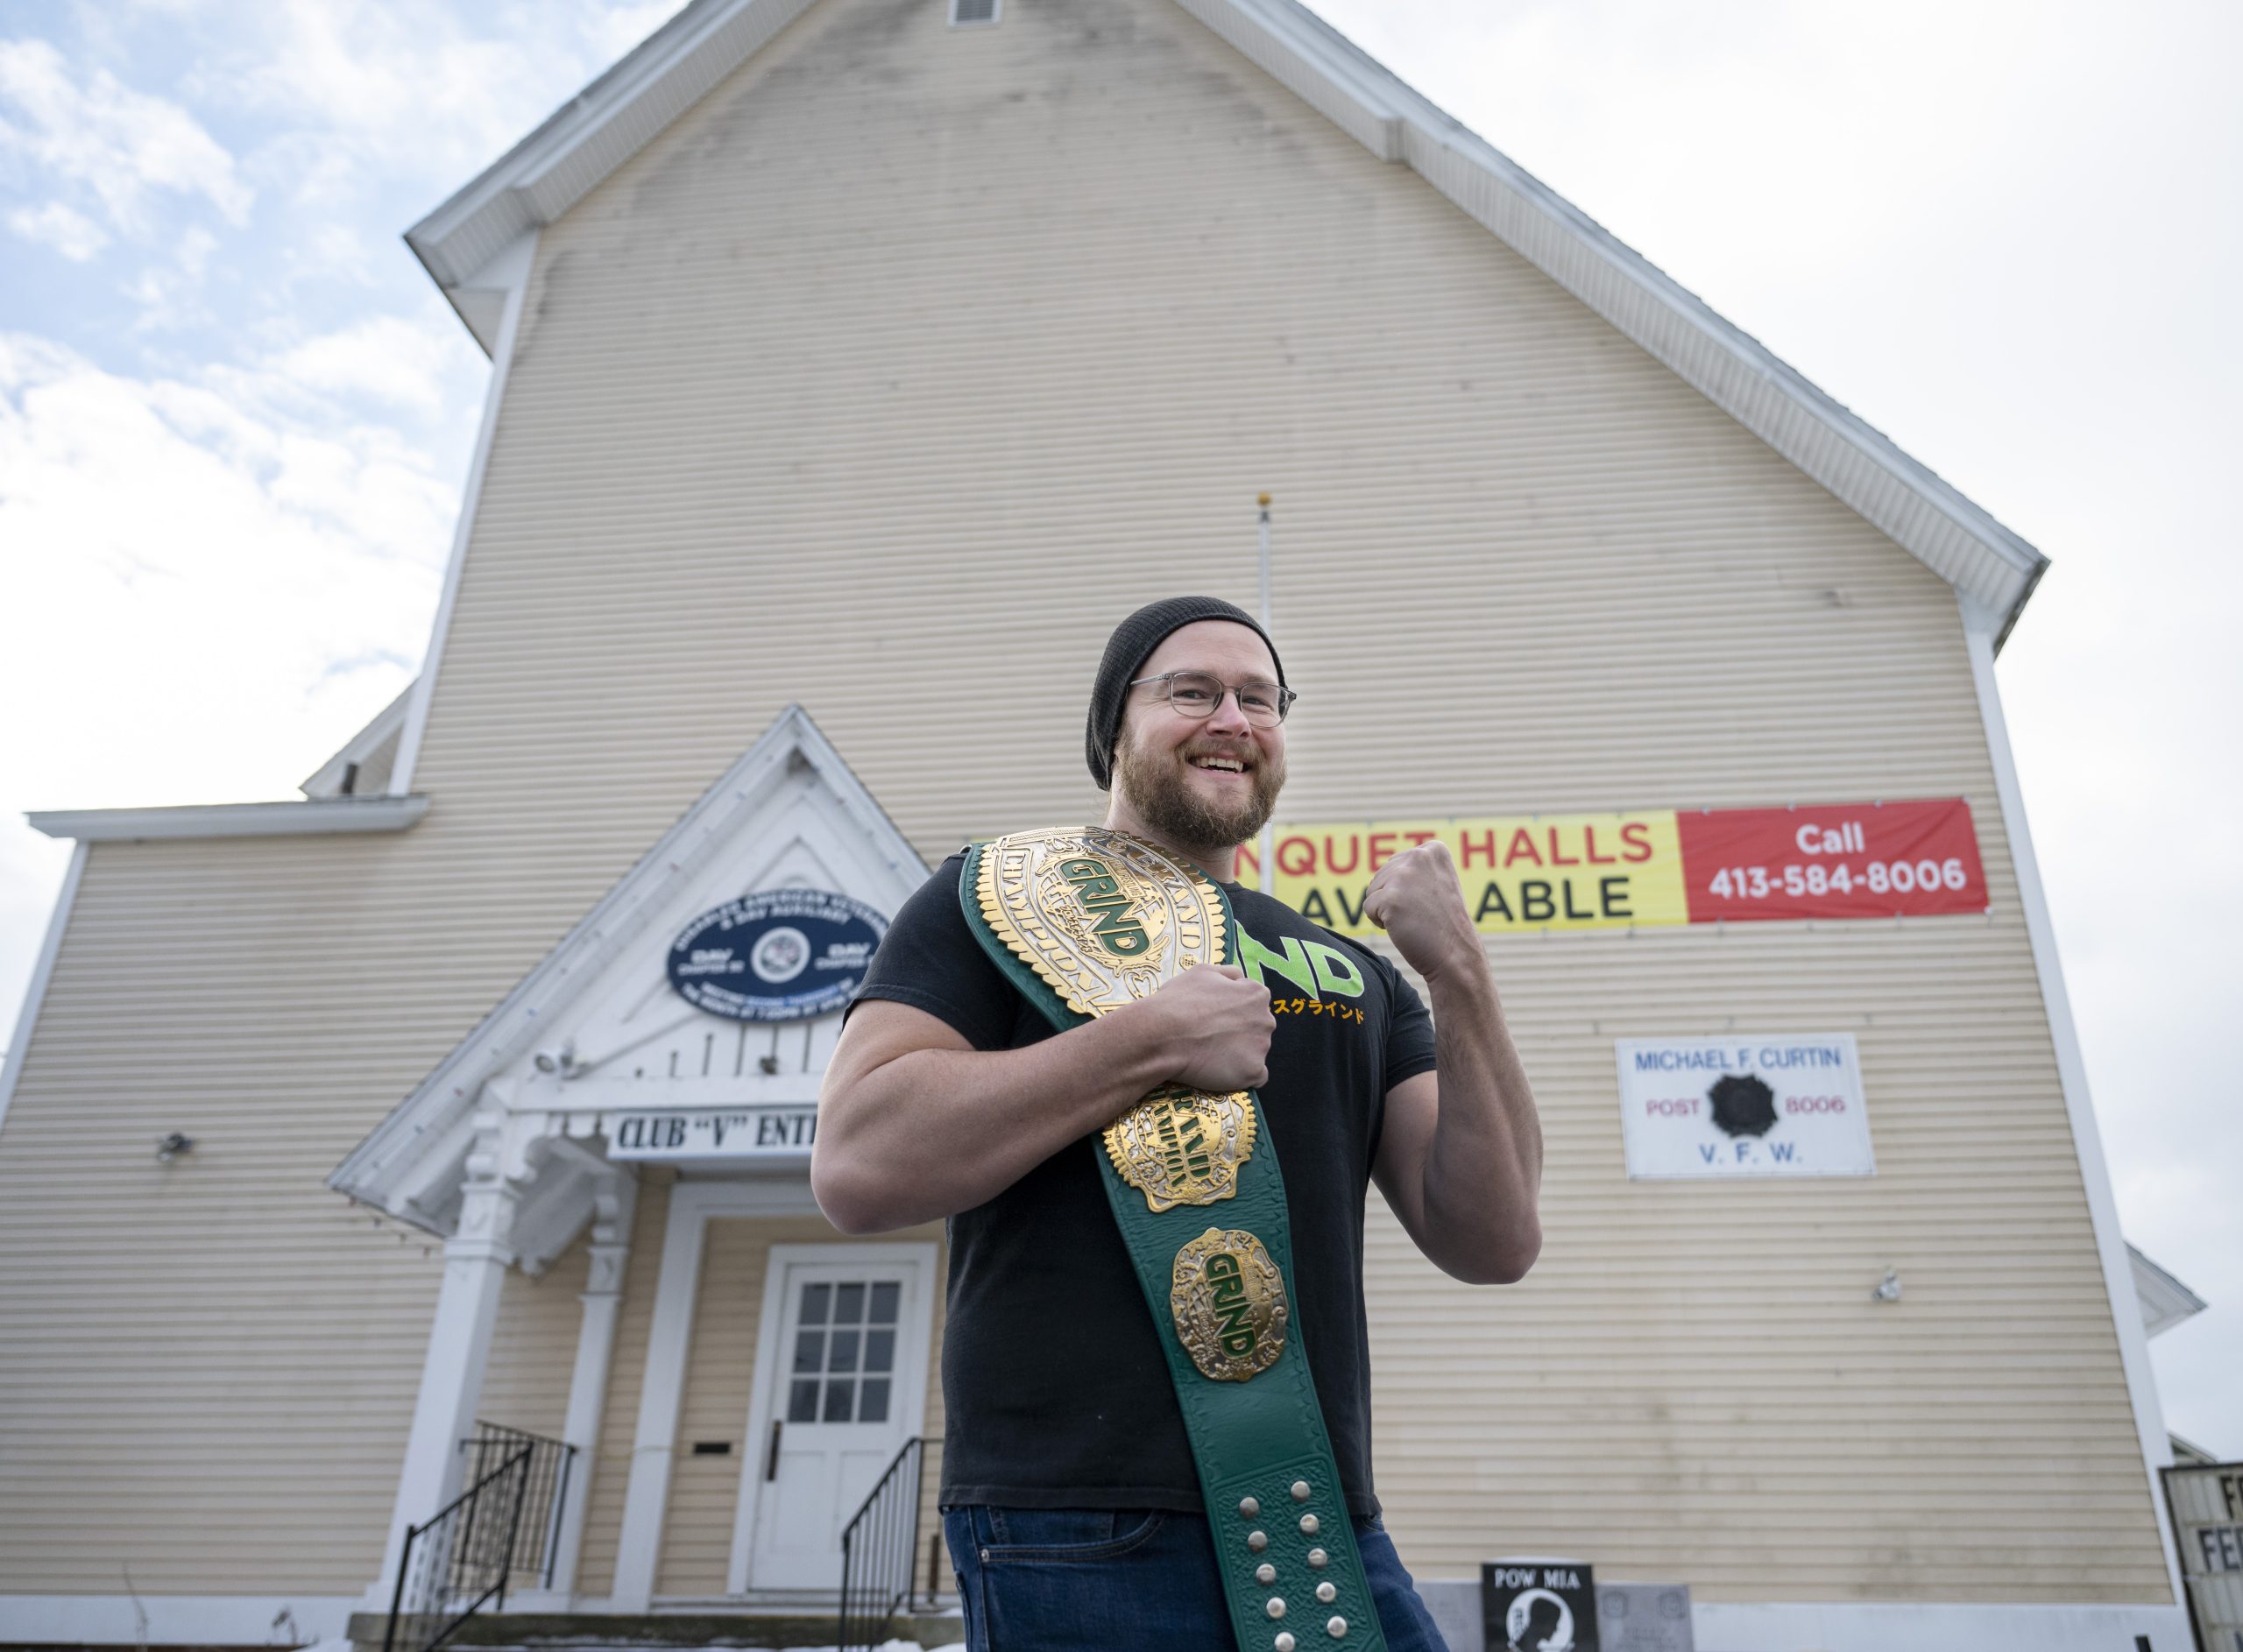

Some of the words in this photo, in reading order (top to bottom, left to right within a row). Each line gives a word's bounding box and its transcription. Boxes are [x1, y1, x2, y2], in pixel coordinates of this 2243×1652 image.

[1234, 831, 1437, 879] NQUET
[1461, 822, 1653, 869] HALLS
[1796, 822, 1865, 855] Call
[1709, 858, 1967, 900] 413-584-8006
[1002, 851, 1101, 992] CHAMPION
[1059, 858, 1151, 957] GRIND
[1301, 877, 1634, 927] AVABLE
[1235, 921, 1364, 1000] ND
[1273, 998, 1364, 1025] スグラインド
[1634, 1049, 1732, 1072] MICHAEL
[1759, 1047, 1842, 1070] CURTIN
[1645, 1098, 1701, 1117] POST
[619, 1117, 686, 1147] CLUB
[1171, 1090, 1210, 1177] RAND
[1699, 1142, 1724, 1164] V.
[1736, 1142, 1760, 1164] F.
[1769, 1141, 1804, 1163] W.
[1205, 1253, 1257, 1359] GRIND
[1494, 1568, 1537, 1589] POW
[1543, 1569, 1581, 1590] MIA
